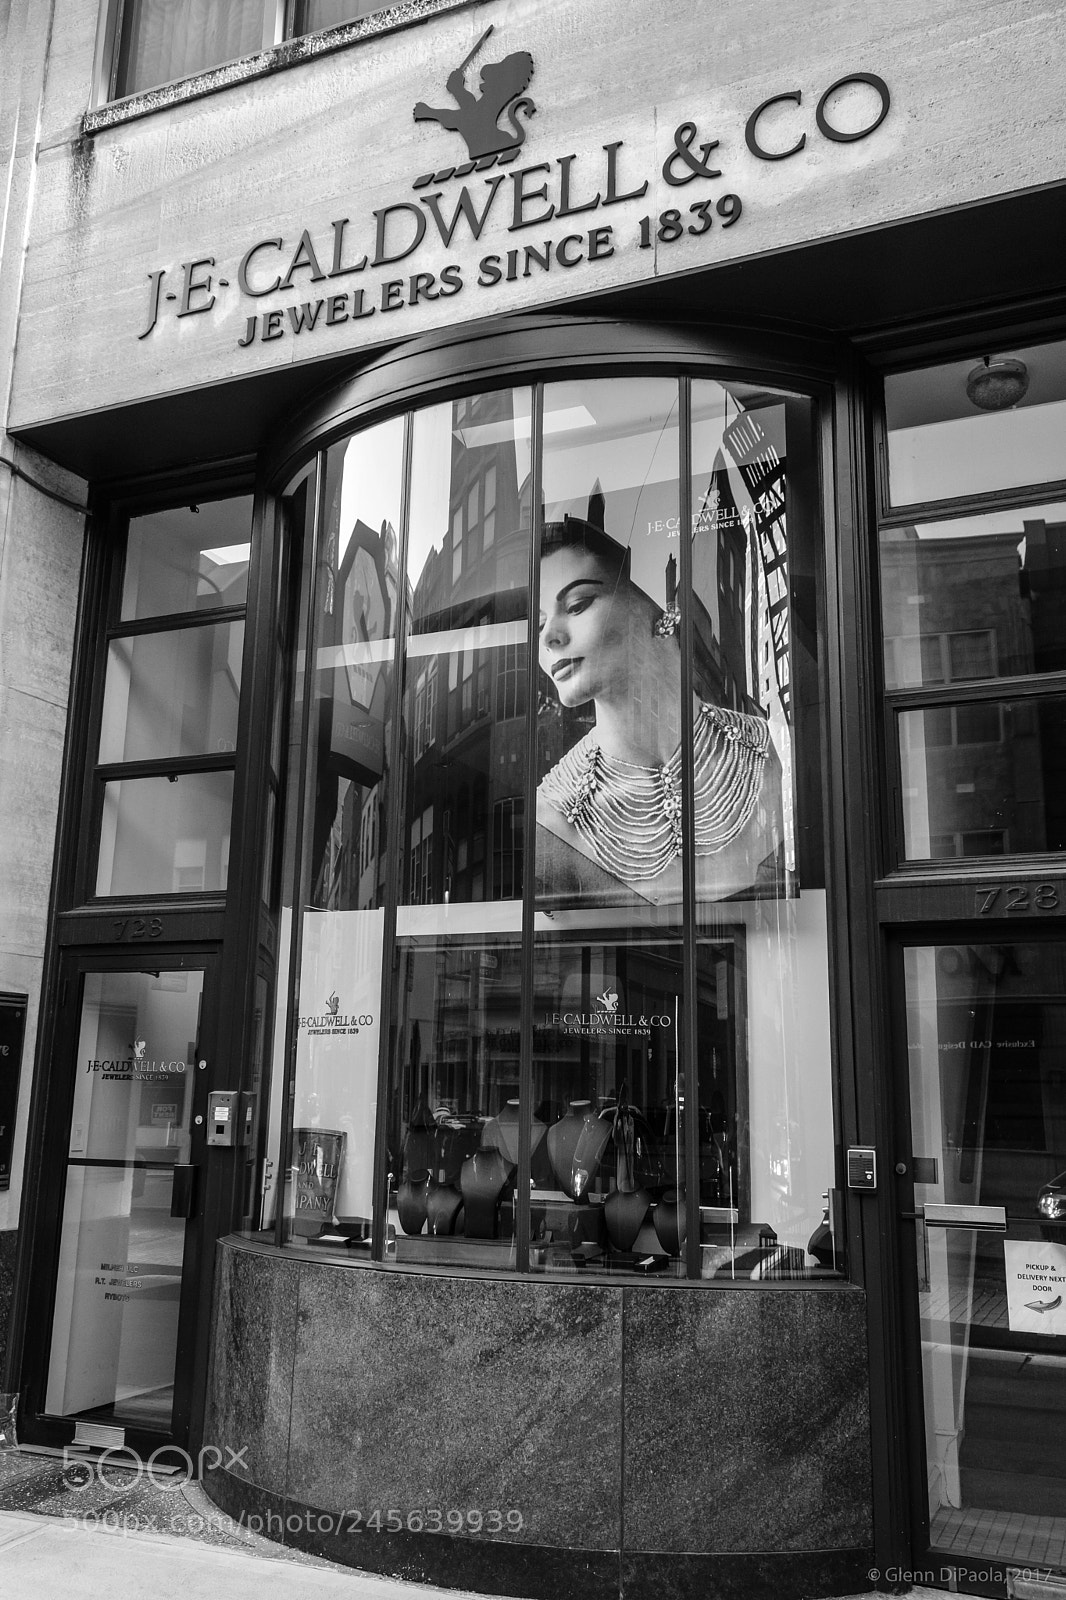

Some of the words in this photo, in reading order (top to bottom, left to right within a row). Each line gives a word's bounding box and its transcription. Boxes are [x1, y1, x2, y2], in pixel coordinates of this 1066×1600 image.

[662, 122, 722, 187] &
[745, 72, 891, 161] CO
[238, 265, 463, 347] JEWELERS
[477, 225, 615, 287] SINCE
[639, 193, 743, 249] 1839
[667, 524, 710, 539] JEWERS
[711, 520, 735, 530] SINCE
[737, 516, 754, 527] 19
[976, 884, 1060, 914] 728
[351, 1016, 357, 1026] &
[358, 1015, 374, 1026] CO
[638, 1016, 648, 1027] &
[650, 1015, 671, 1027] CO
[159, 1061, 167, 1072] &
[168, 1061, 186, 1073] CO
